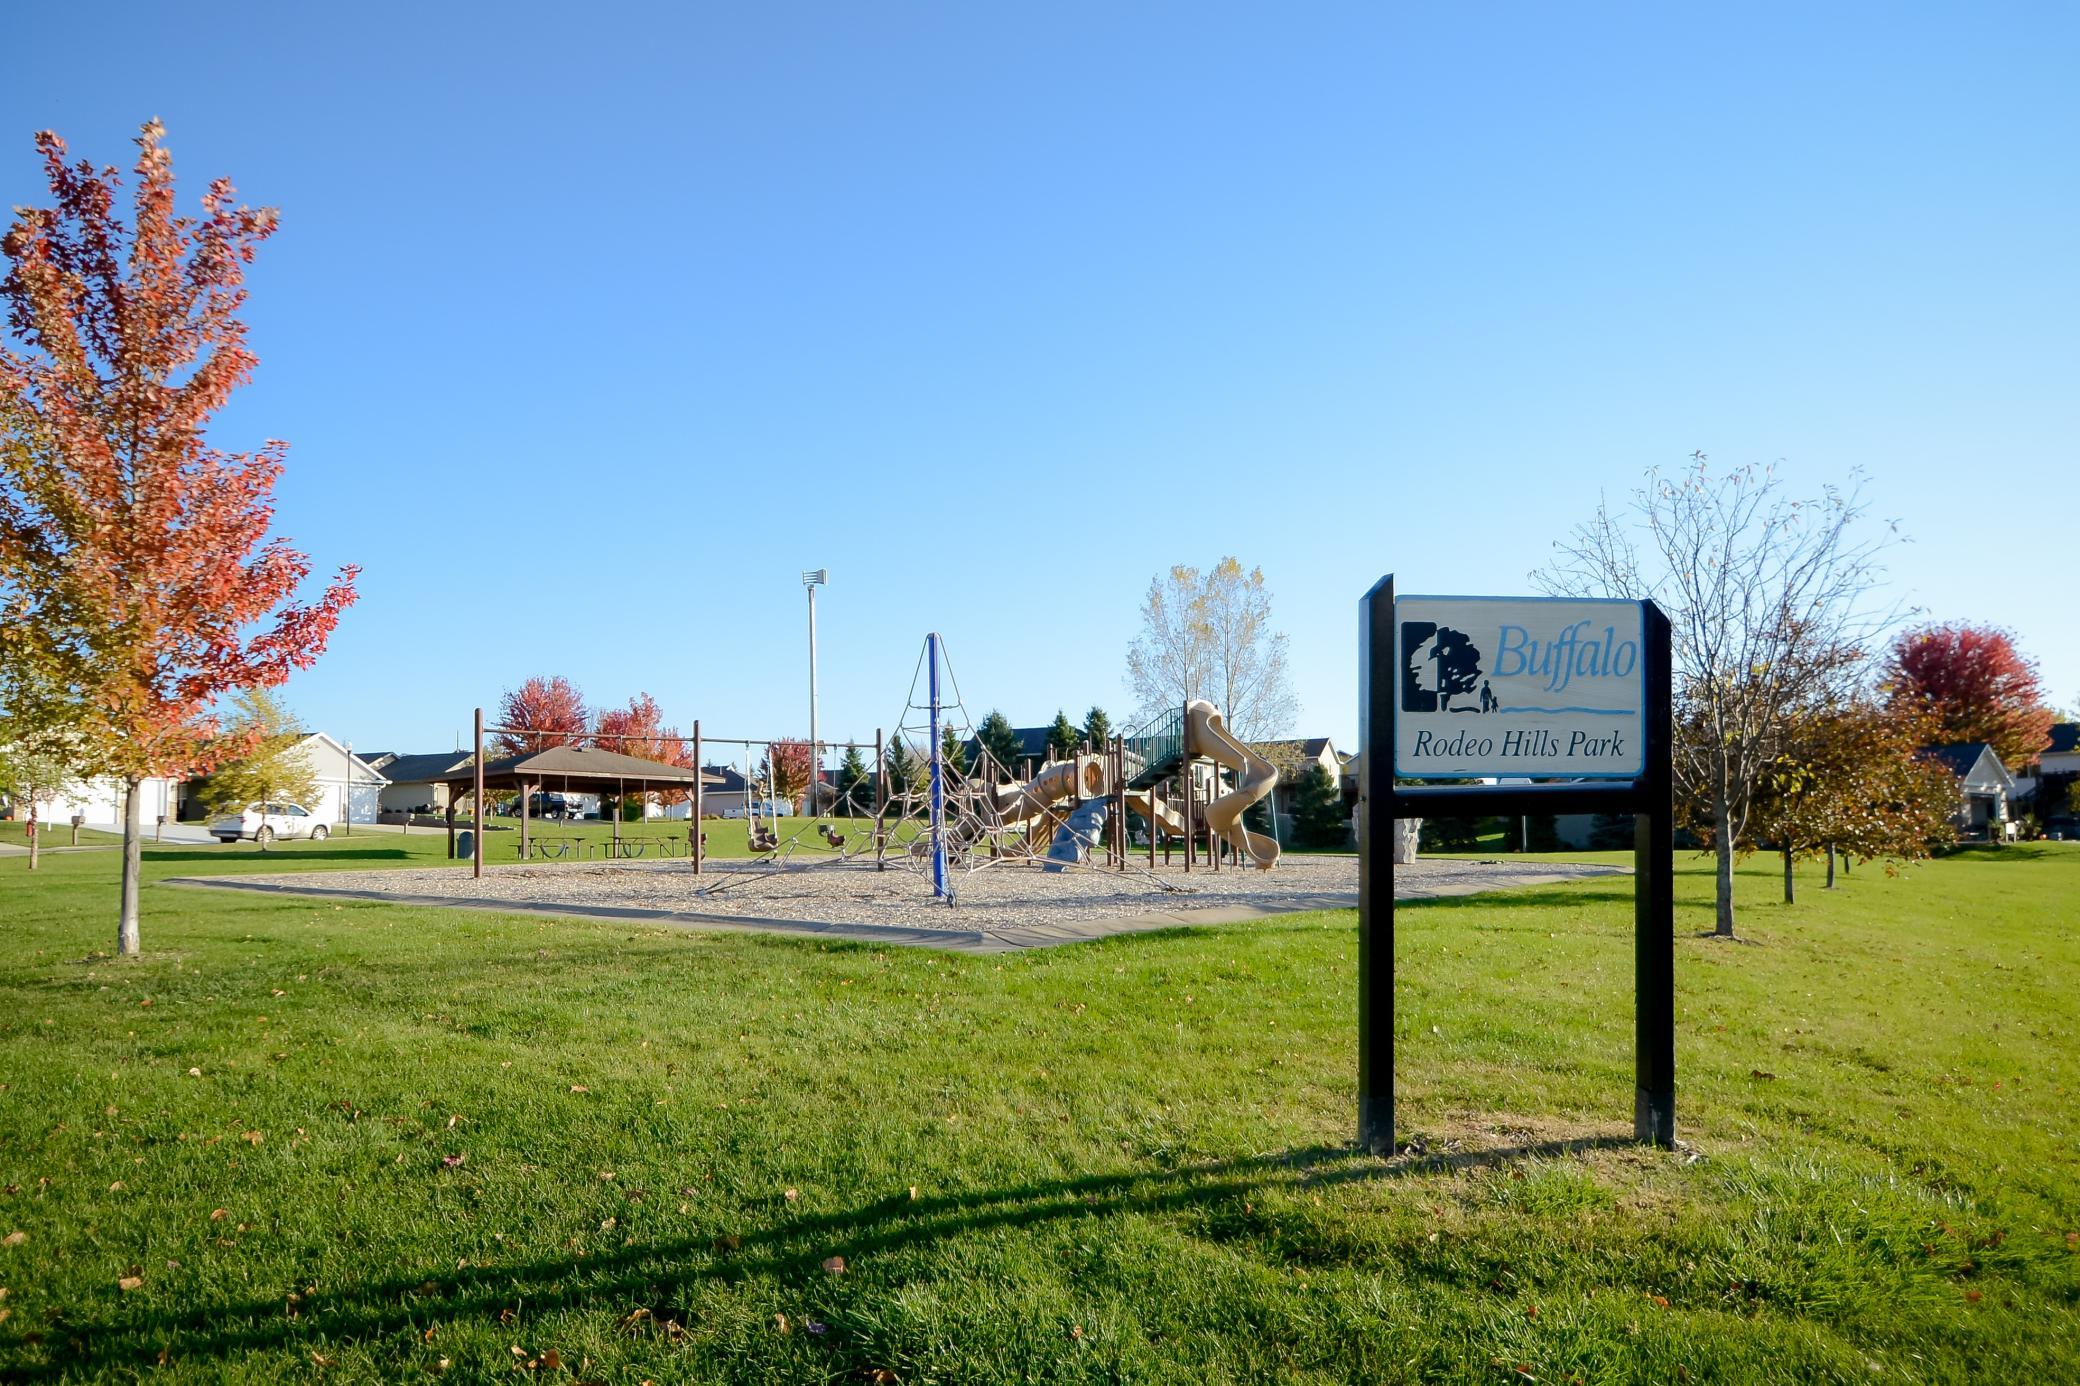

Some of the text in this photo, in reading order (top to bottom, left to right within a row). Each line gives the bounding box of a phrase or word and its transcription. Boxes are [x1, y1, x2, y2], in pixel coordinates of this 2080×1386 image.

[1492, 620, 1637, 692] Buffalo
[1412, 730, 1625, 757] Rodeo Hills Park
